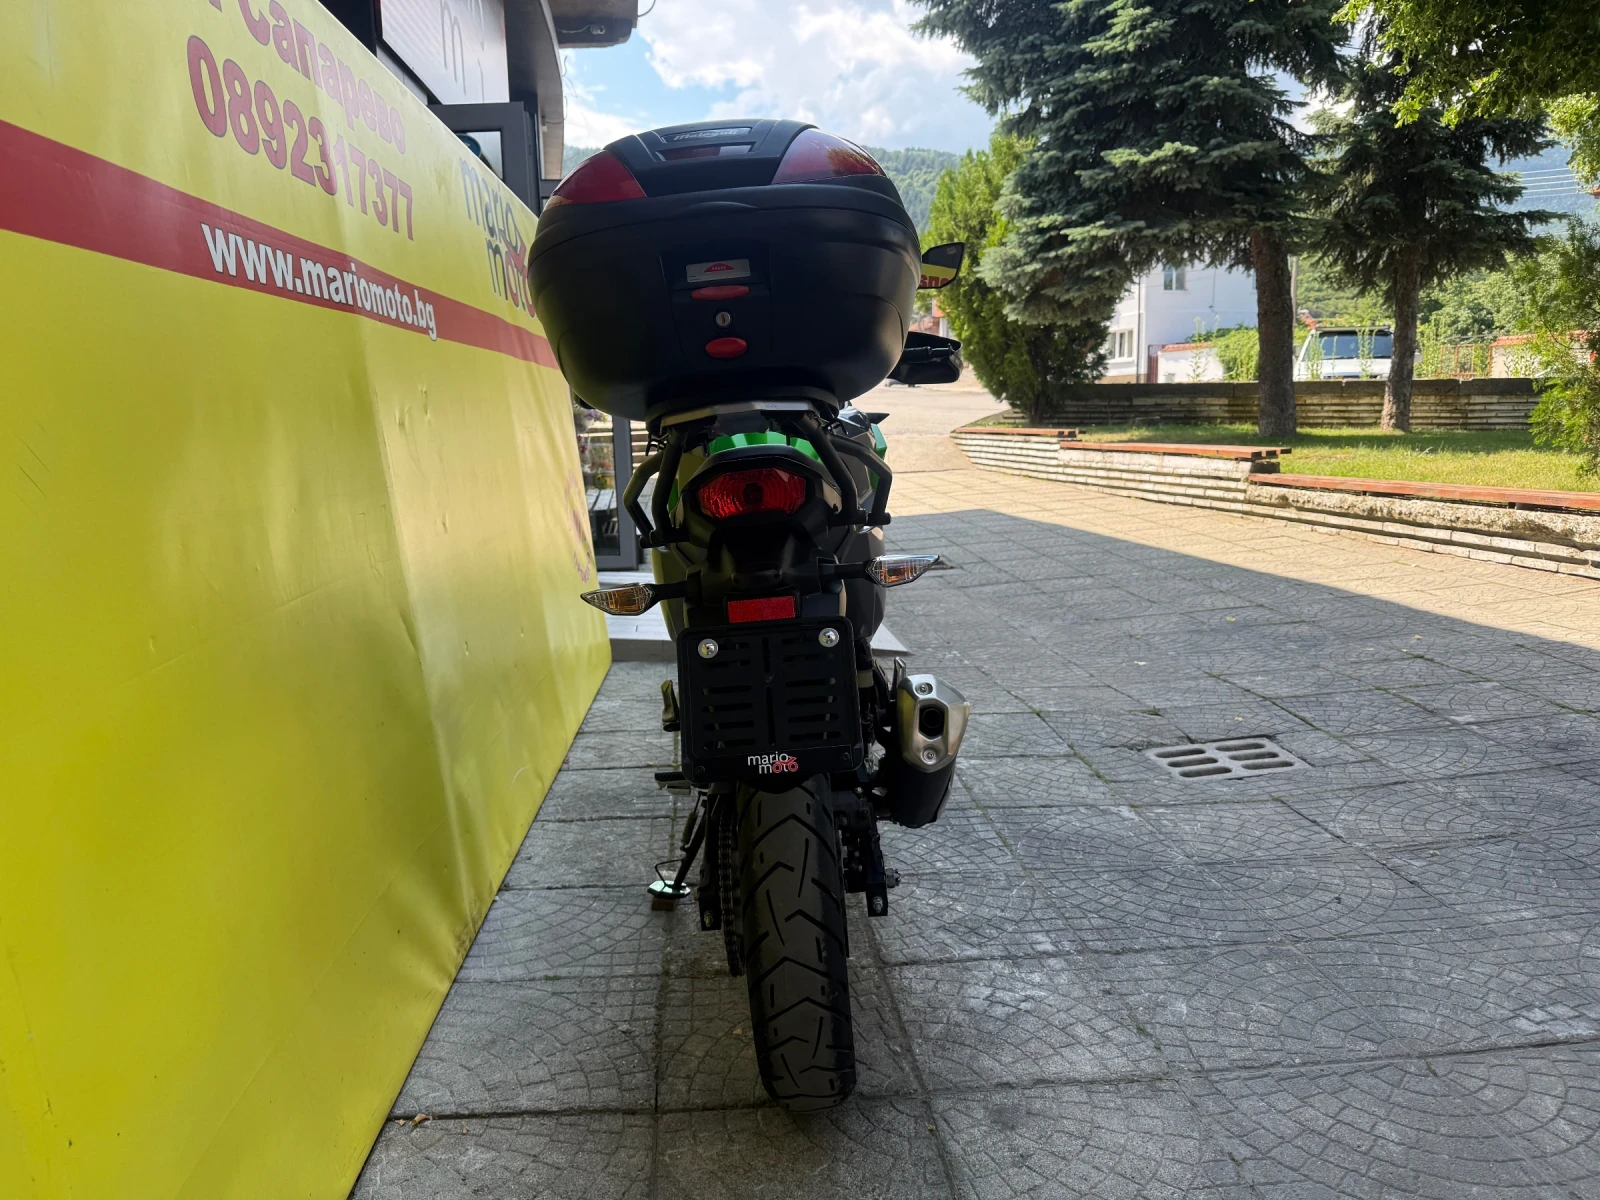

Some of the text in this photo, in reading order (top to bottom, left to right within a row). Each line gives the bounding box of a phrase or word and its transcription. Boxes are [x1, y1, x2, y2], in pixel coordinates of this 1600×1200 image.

[187, 35, 413, 241] 0892317377
[459, 157, 519, 257] mario
[200, 222, 438, 341] www.mariomoto.bg
[747, 751, 789, 766] mario
[759, 761, 799, 774] moto
